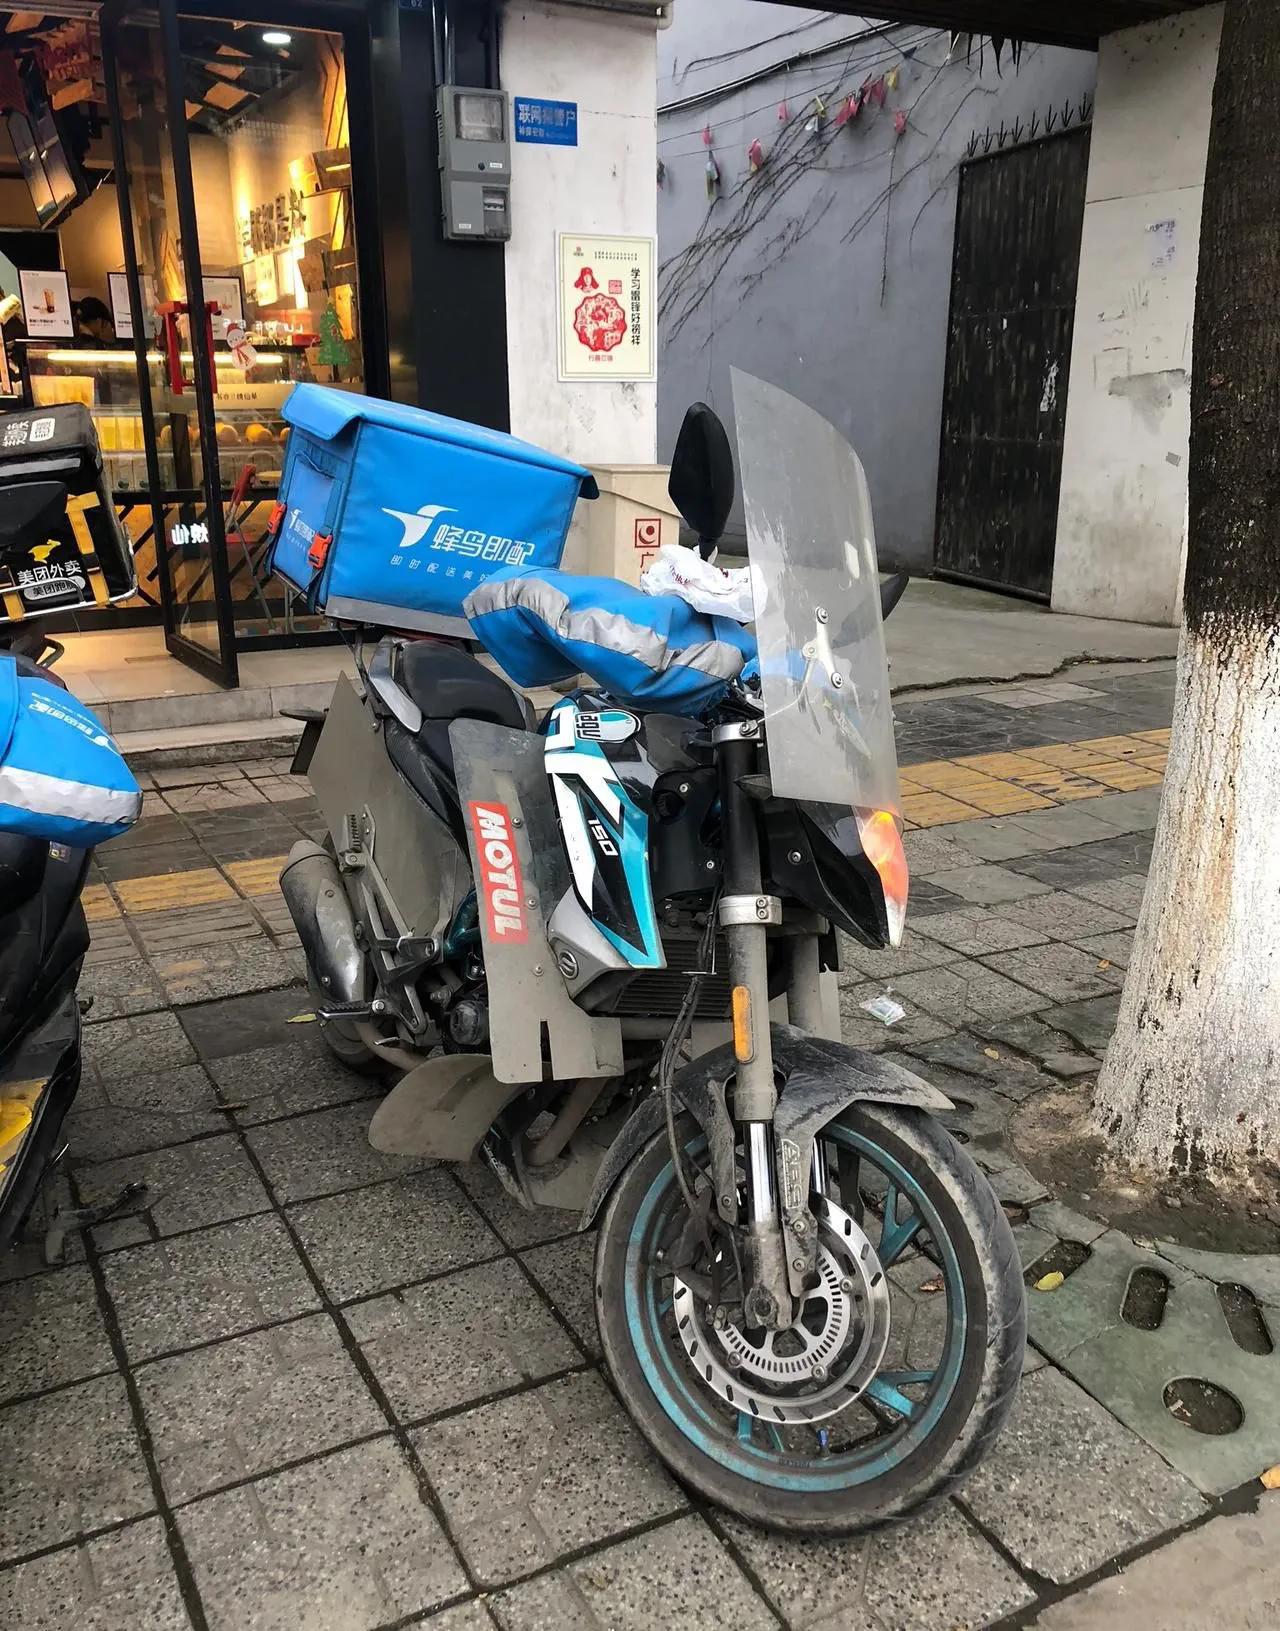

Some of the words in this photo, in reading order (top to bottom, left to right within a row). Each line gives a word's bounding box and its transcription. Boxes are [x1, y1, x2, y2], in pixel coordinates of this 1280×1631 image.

[518, 103, 576, 128] 联网户
[430, 523, 535, 566] 蜂鸟即配
[17, 559, 82, 586] 美团外卖
[587, 818, 619, 856] 150
[475, 806, 522, 936] MOTUL
